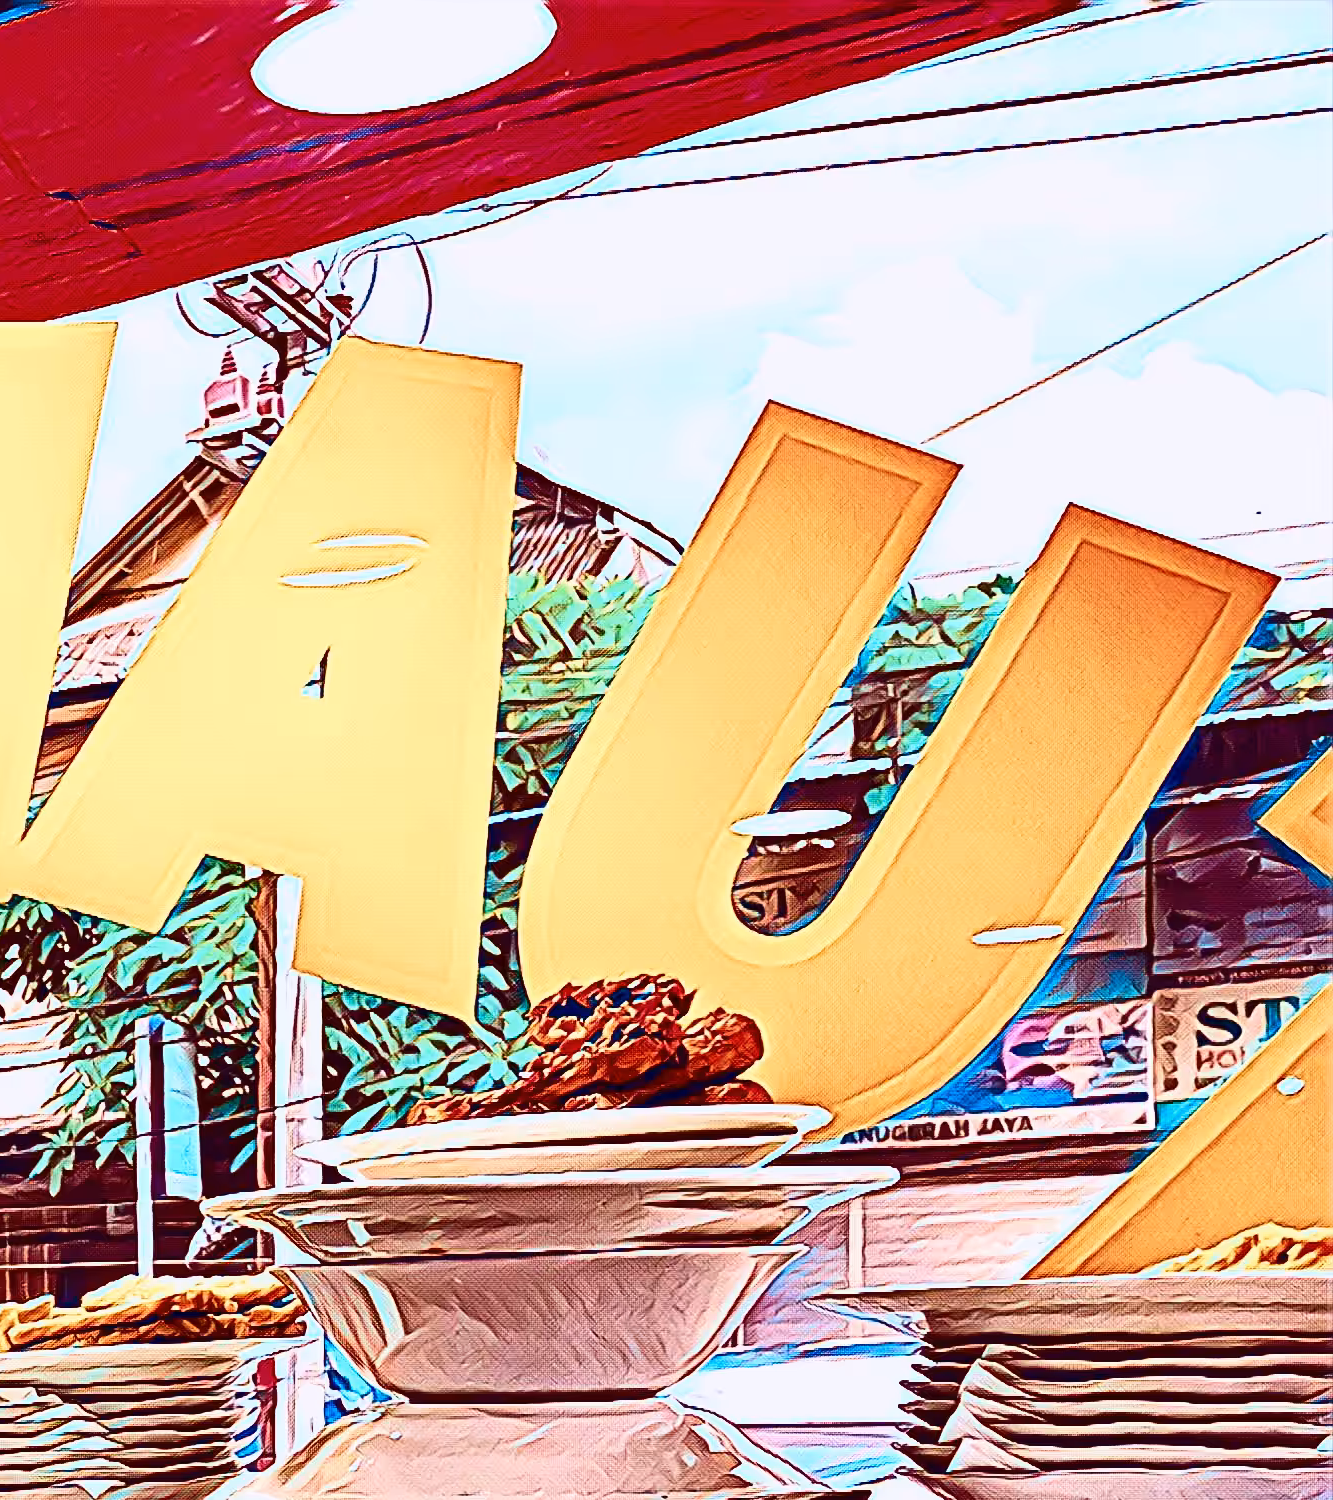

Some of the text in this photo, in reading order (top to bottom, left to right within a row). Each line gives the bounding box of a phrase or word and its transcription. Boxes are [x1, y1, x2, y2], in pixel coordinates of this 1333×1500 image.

[1196, 995, 1301, 1048] ST
[840, 1115, 1033, 1144] ANUGERAH JAYA
